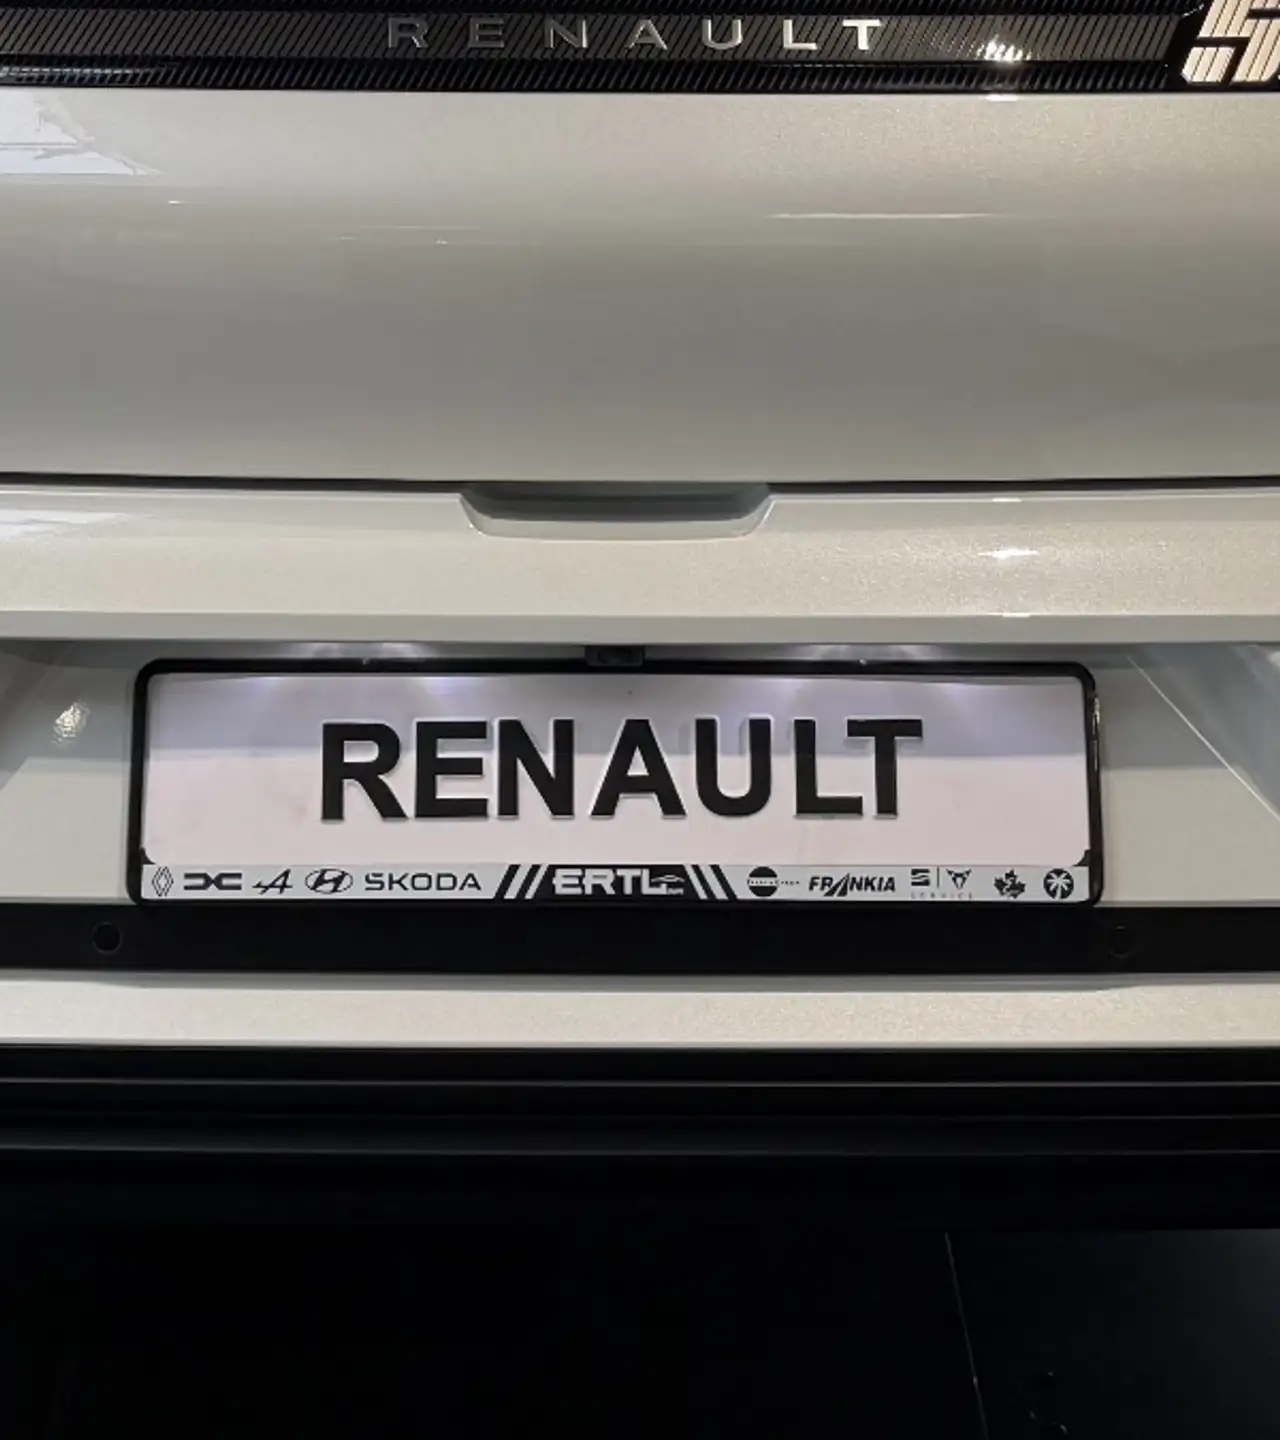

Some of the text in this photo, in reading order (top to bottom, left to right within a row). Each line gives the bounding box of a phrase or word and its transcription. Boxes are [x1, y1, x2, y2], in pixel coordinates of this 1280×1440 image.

[387, 18, 883, 51] RENAULT
[320, 717, 923, 820] RENAULT
[552, 868, 668, 896] ERTL
[808, 872, 897, 897] FRANKIA
